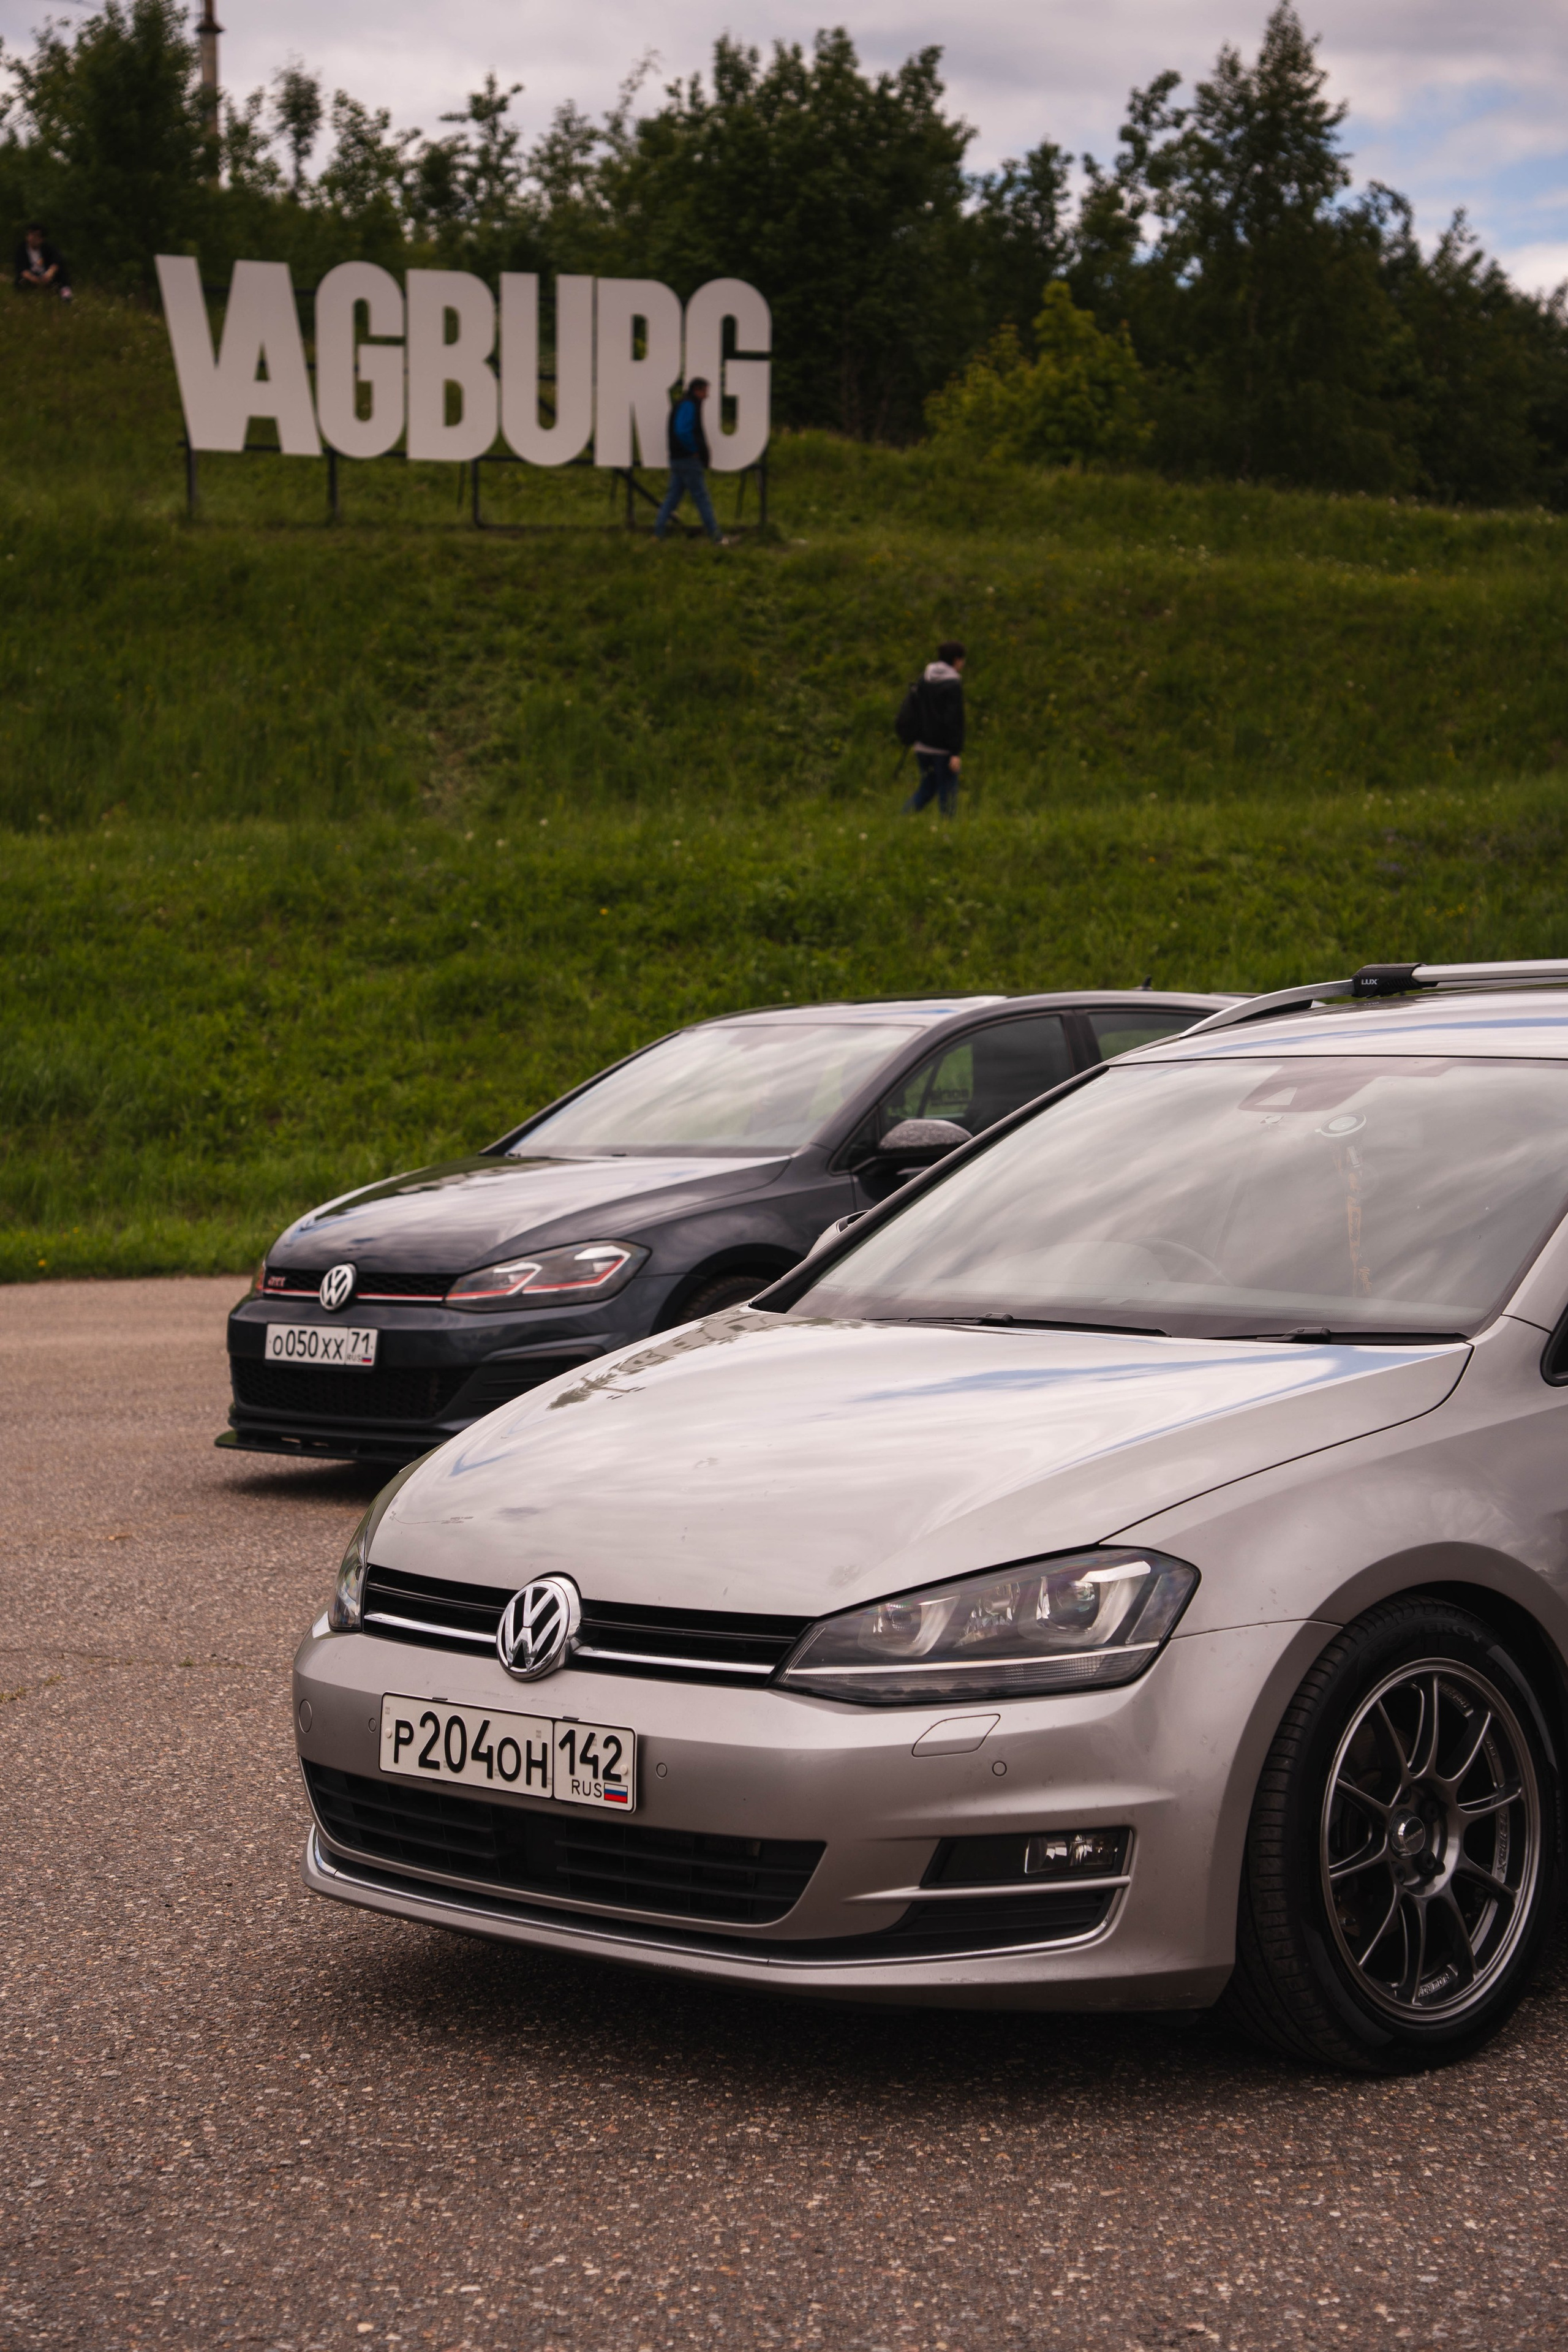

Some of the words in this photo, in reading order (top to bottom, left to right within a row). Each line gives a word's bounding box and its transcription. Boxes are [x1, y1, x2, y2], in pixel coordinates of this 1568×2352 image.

[154, 254, 772, 472] VAGBURG
[351, 1332, 370, 1354] 71
[347, 1354, 361, 1363] RUS
[558, 1728, 622, 1783] 142
[571, 1779, 603, 1798] RUS
